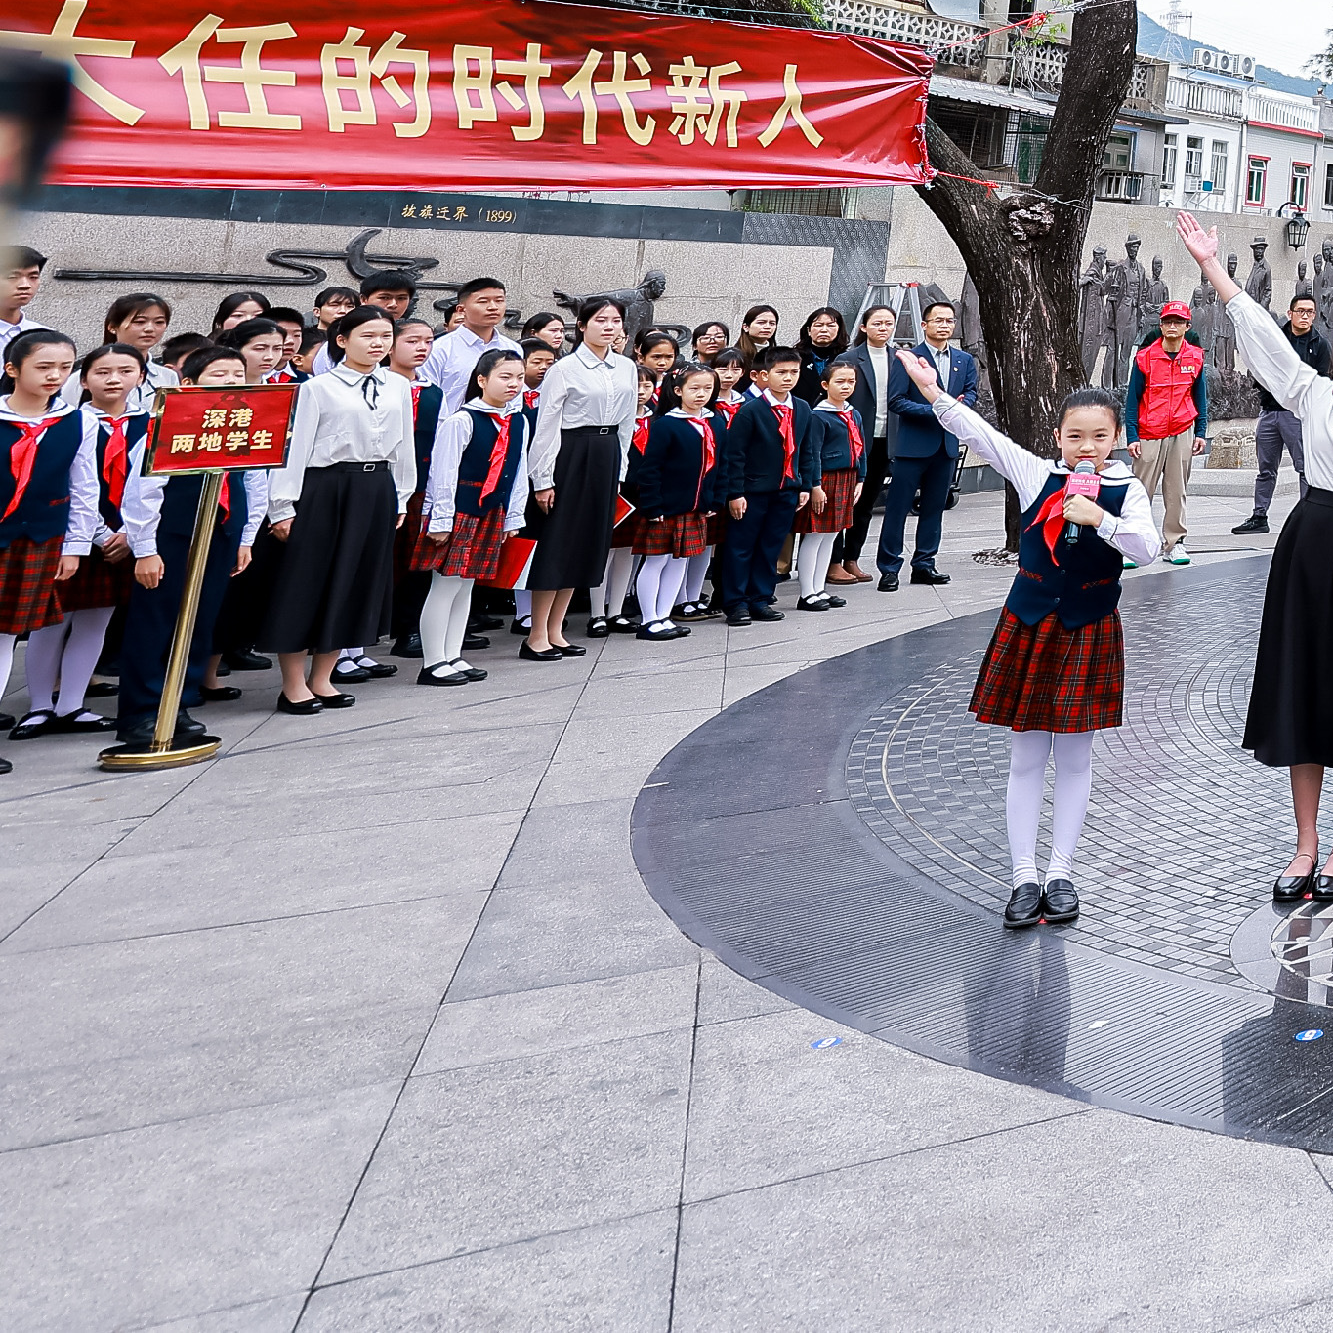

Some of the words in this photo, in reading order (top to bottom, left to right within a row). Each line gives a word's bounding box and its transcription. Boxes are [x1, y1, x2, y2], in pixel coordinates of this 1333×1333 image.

[201, 407, 254, 429] 深港
[170, 429, 273, 454] 两地学生
